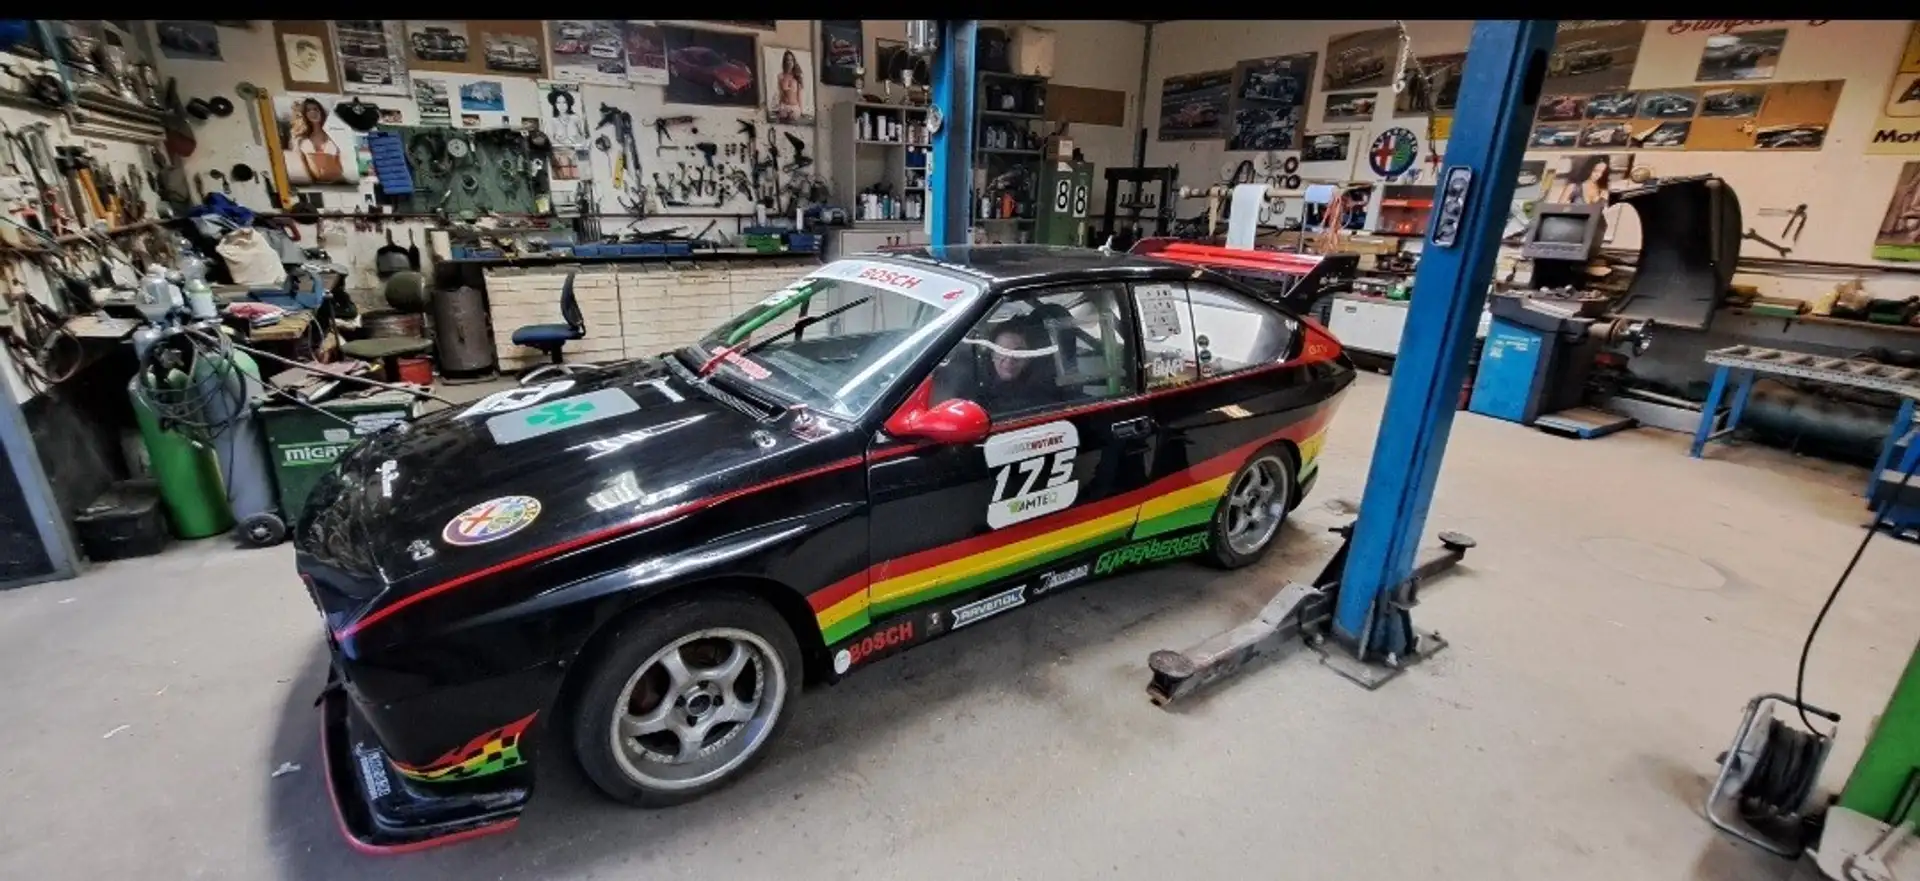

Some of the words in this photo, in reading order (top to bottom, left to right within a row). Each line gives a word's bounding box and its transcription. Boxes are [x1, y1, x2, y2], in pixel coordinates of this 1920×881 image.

[858, 268, 922, 288] BOSCH
[991, 448, 1077, 502] 175
[850, 620, 914, 664] BOSCH
